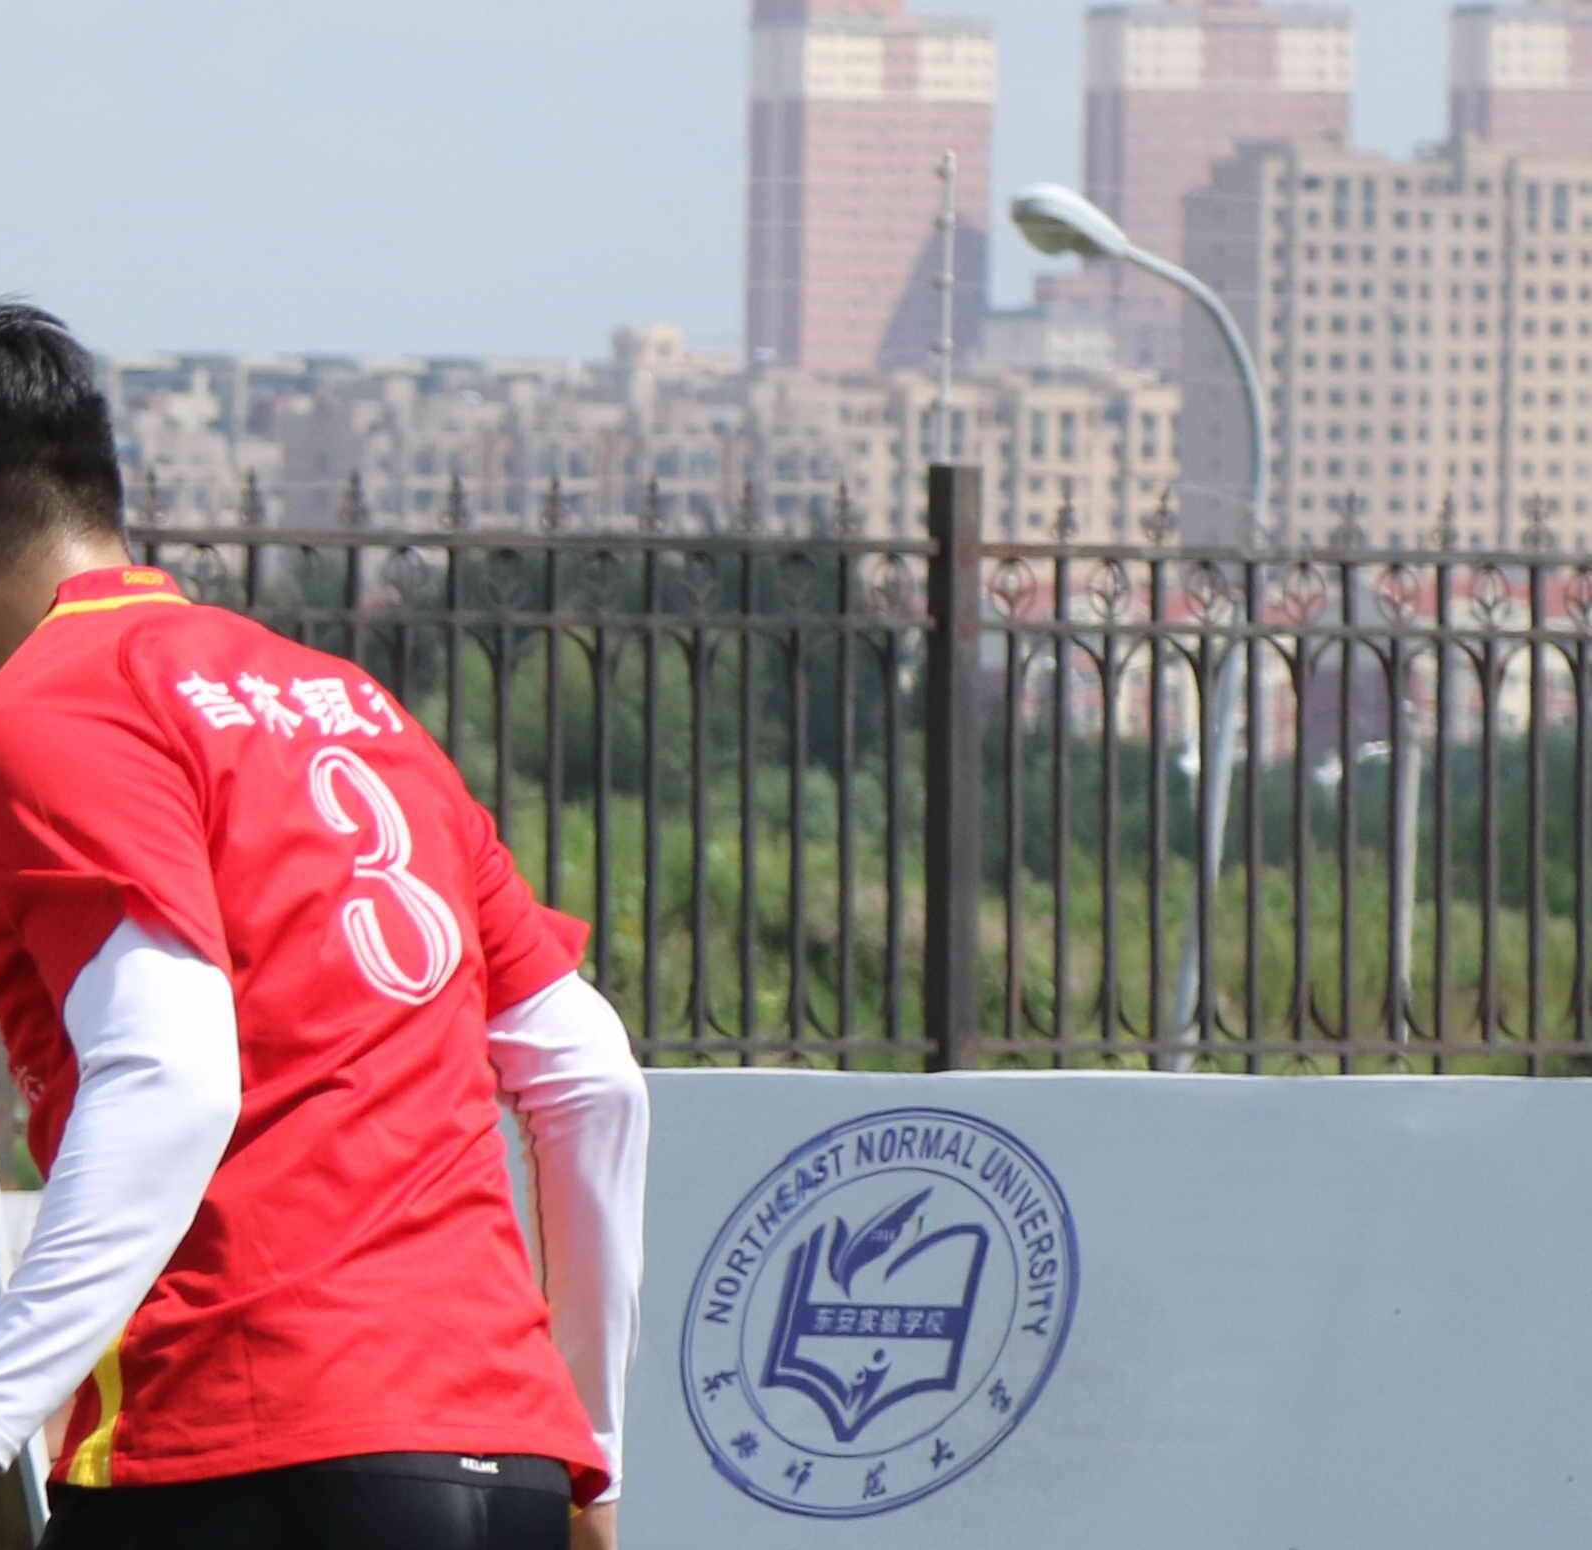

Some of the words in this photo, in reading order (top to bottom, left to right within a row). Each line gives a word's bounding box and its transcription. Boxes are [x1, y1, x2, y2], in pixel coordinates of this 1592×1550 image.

[308, 745, 463, 1005] 3
[703, 1144, 845, 1325] NORTHEAST
[855, 1126, 976, 1170] NORMAL
[979, 1146, 1058, 1338] UNIVERSITY
